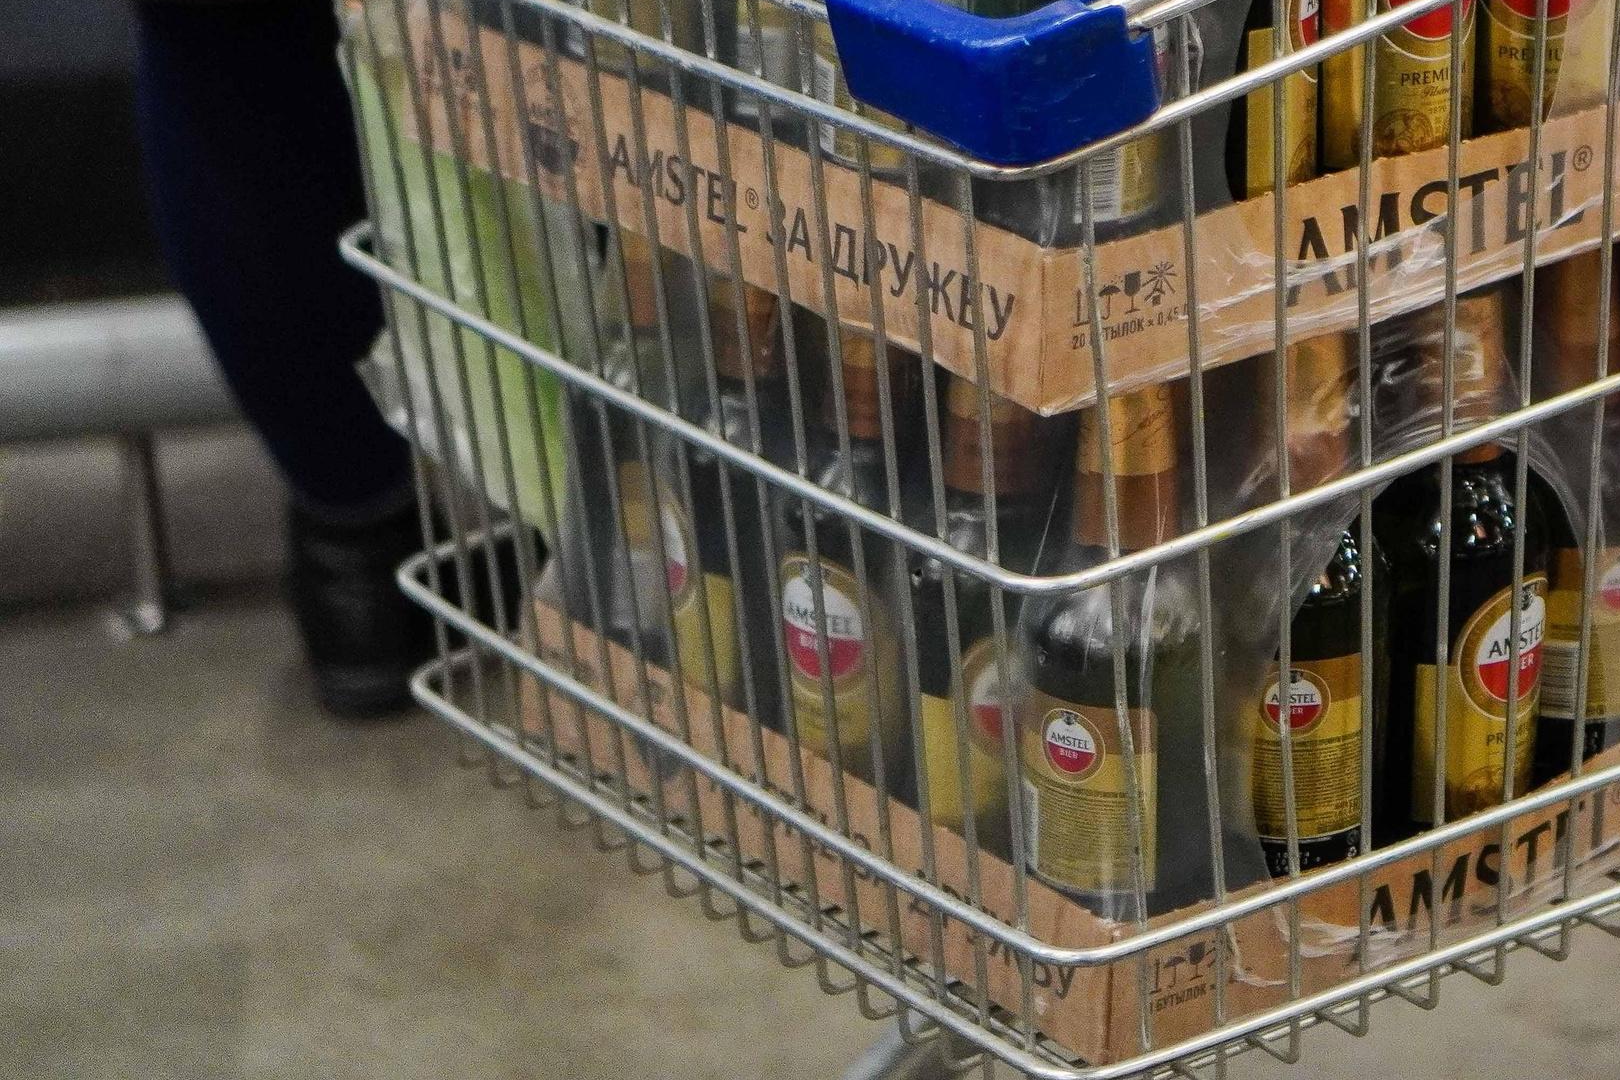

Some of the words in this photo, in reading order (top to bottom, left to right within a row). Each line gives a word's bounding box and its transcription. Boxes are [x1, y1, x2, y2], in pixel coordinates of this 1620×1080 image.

[1400, 59, 1467, 87] PREMI
[1094, 318, 1145, 343] ТЫЛОК
[1271, 693, 1317, 704] ASTEL
[1050, 731, 1089, 750] AMSTEL
